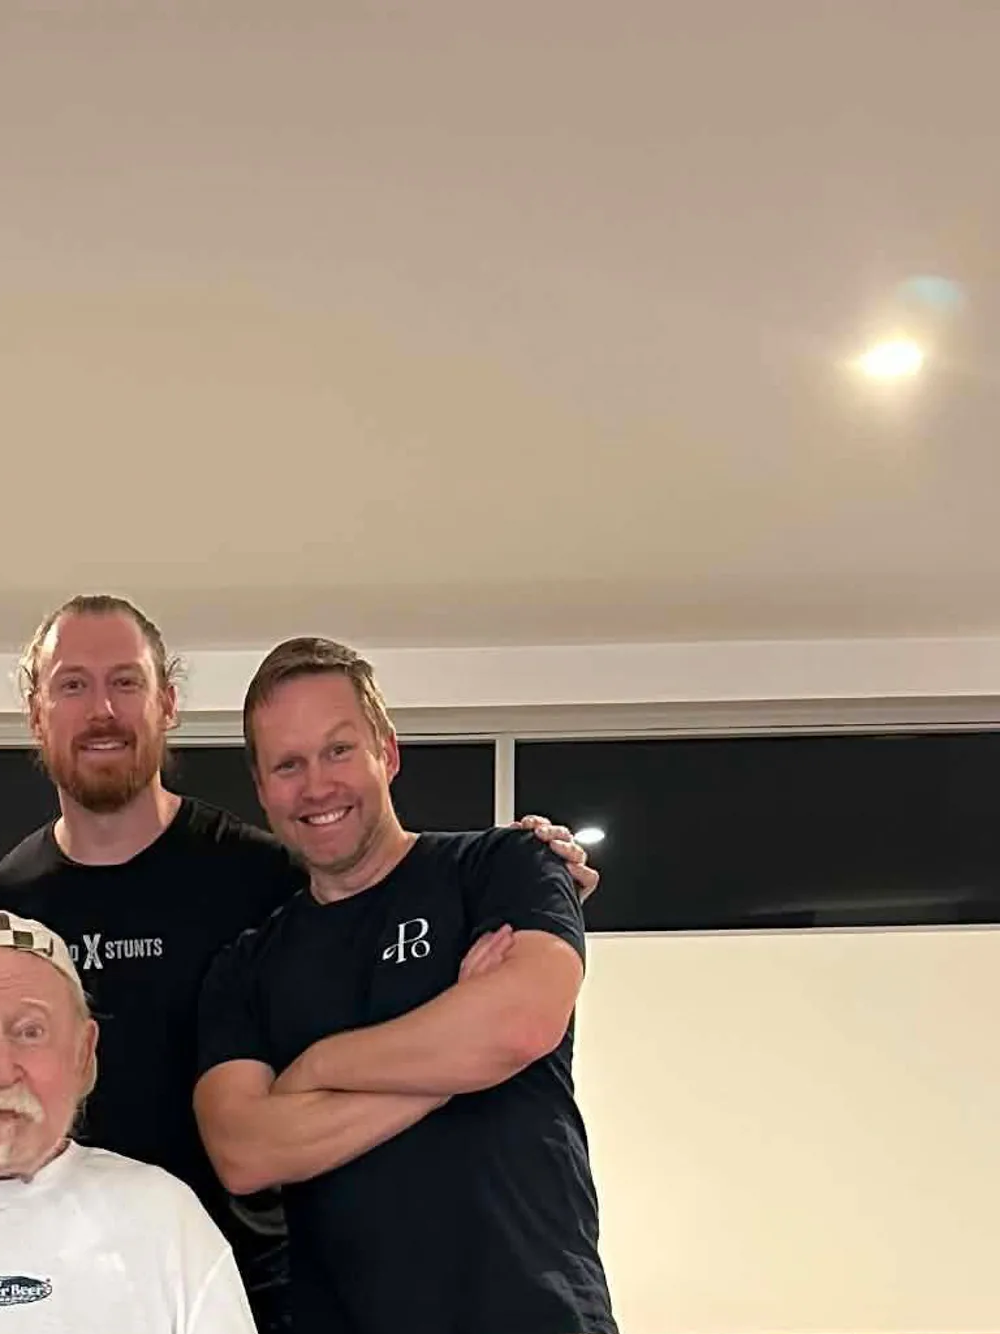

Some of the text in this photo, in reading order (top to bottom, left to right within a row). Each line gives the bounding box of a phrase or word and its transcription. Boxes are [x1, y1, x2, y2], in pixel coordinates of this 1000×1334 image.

[82, 933, 104, 971] X
[104, 937, 163, 960] STUNTS
[10, 1283, 42, 1298] Beer
